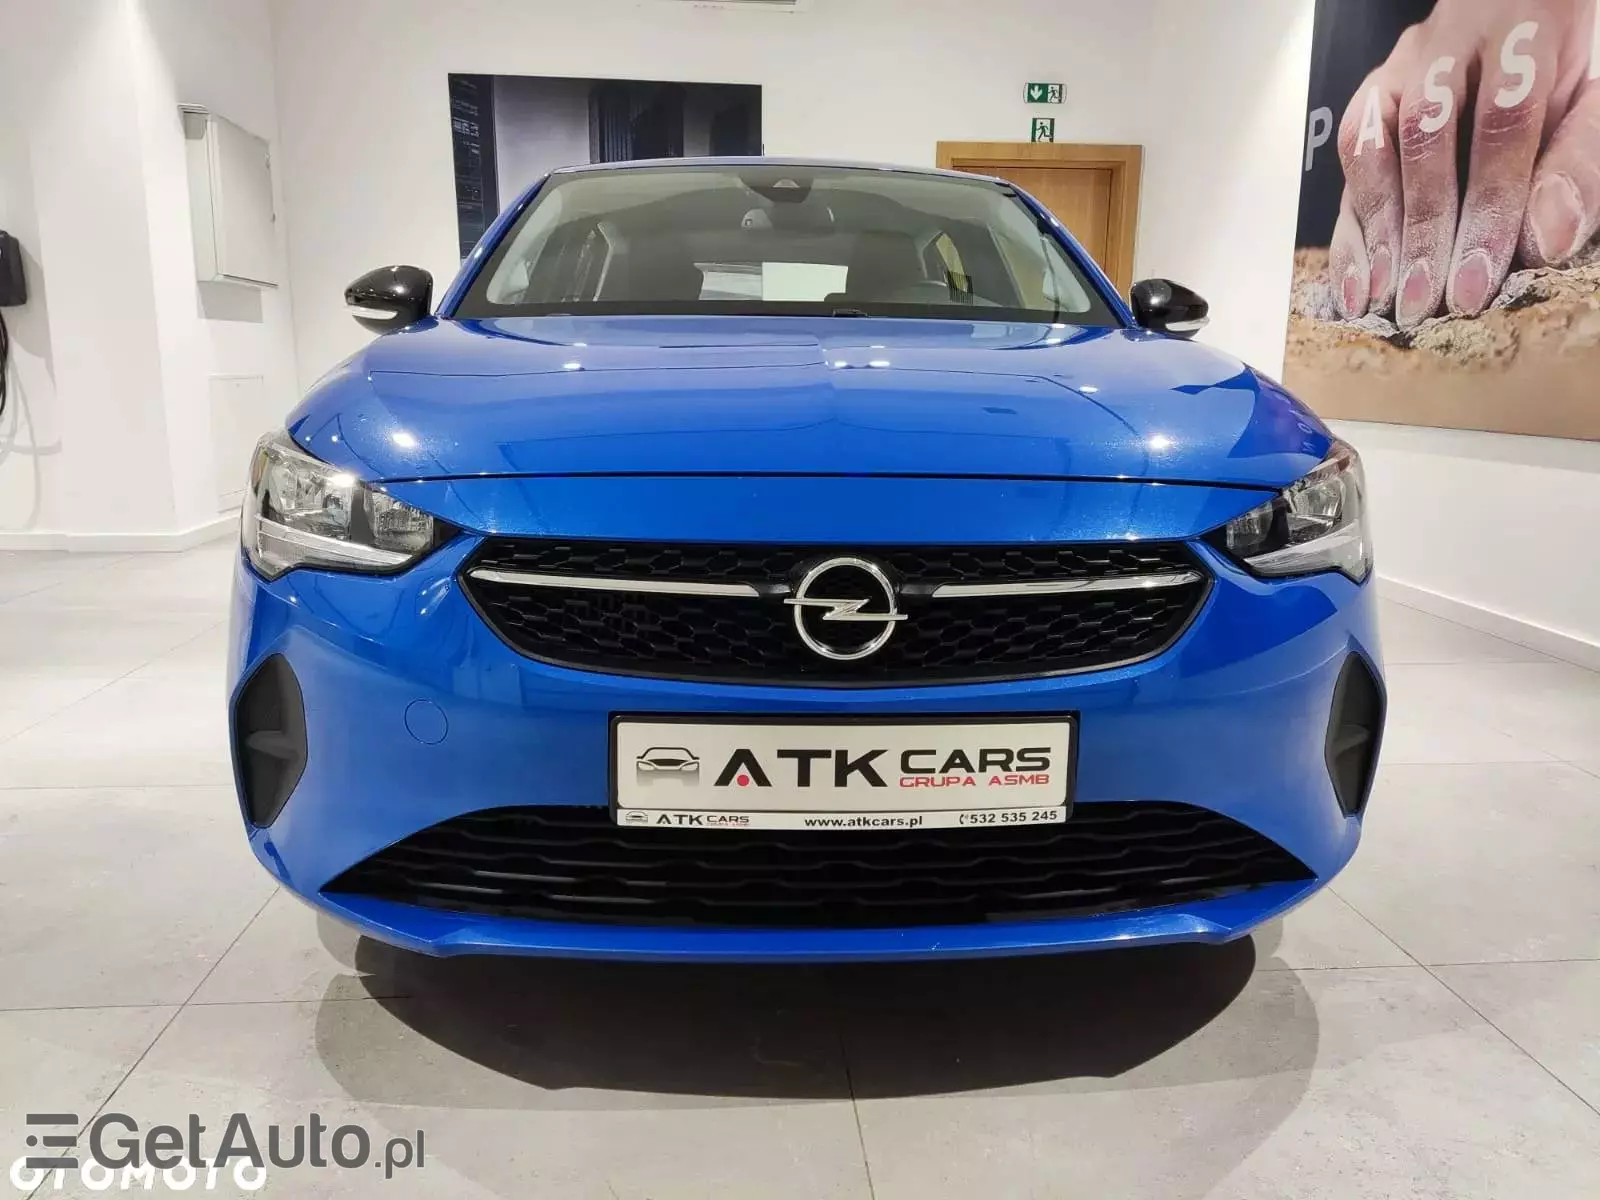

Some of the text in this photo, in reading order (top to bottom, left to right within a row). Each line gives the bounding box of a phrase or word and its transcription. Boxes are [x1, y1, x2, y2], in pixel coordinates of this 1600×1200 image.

[713, 747, 1051, 787] ATK CARS
[899, 774, 1050, 788] GRUPA ASMB
[656, 814, 703, 825] ATK
[706, 815, 749, 823] CARS
[804, 815, 923, 827] www.atkcars.pl
[970, 810, 1057, 824] 532 535 245
